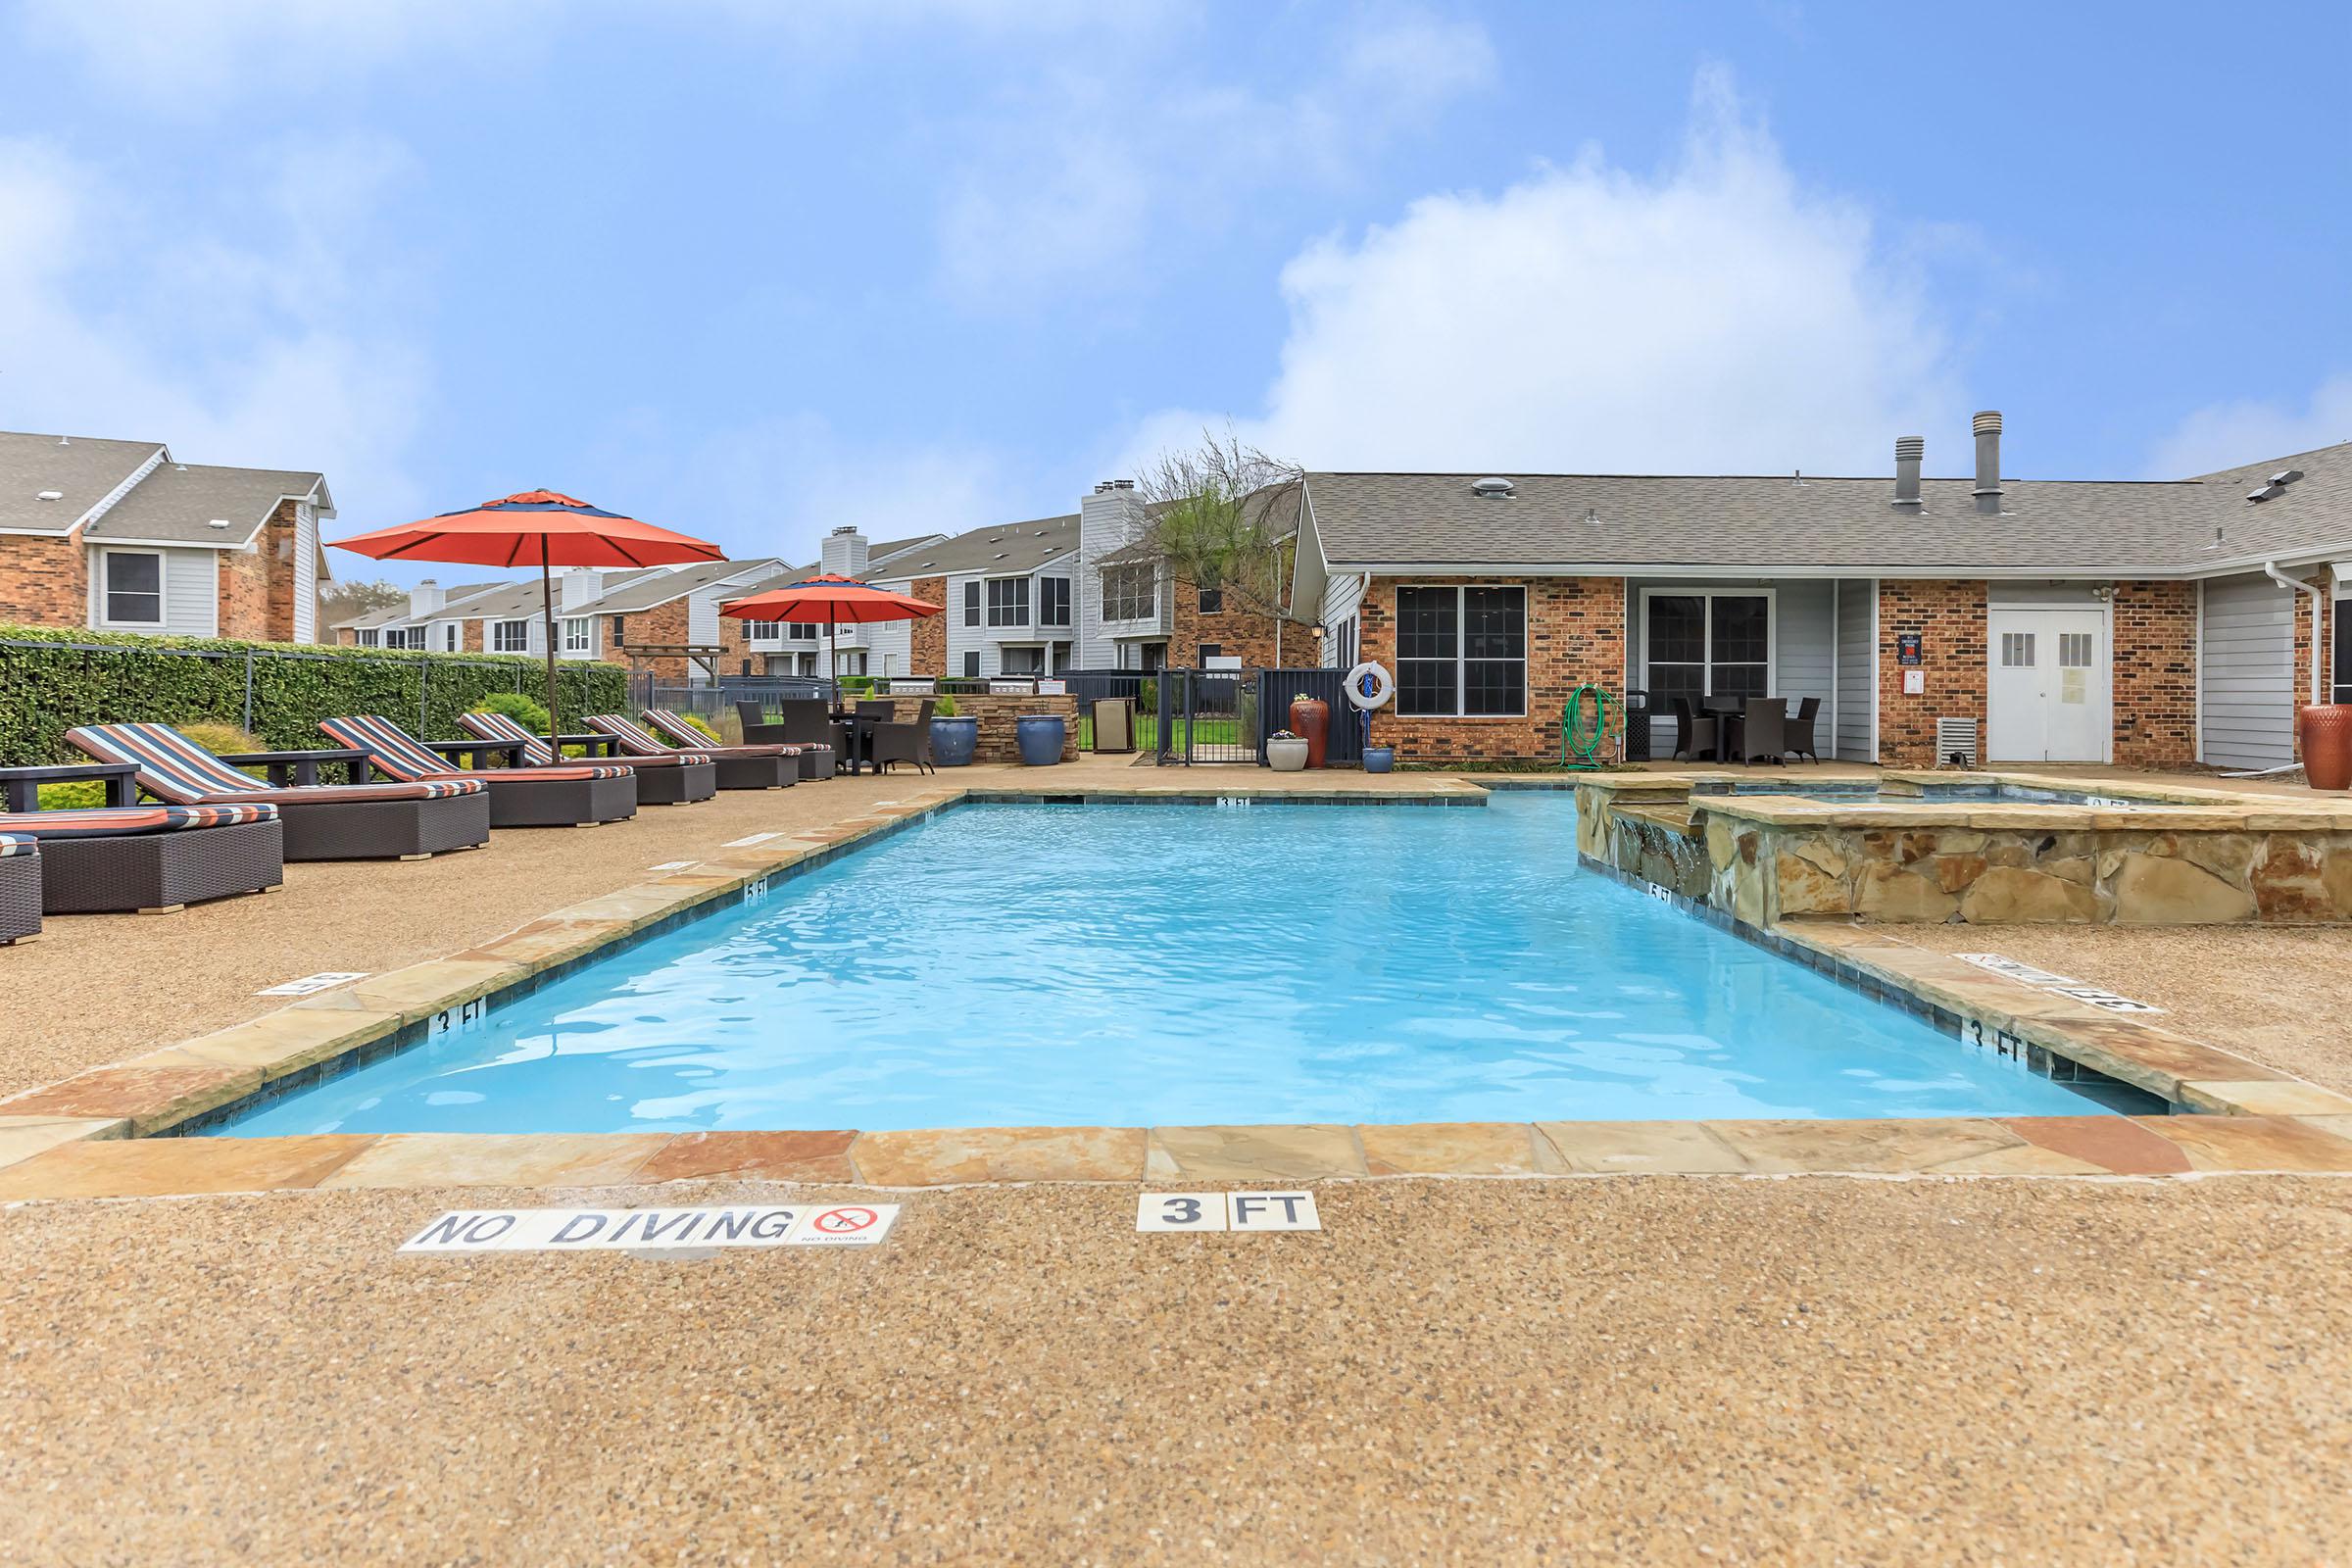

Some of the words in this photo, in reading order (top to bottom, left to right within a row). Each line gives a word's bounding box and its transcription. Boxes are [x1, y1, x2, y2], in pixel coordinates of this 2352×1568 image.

[1221, 797, 1229, 807] 3
[1236, 797, 1248, 806] FT
[437, 1009, 450, 1035] 3
[463, 997, 482, 1026] FT
[1971, 1019, 1984, 1048] 3
[1998, 1030, 2023, 1062] FT
[1161, 1198, 1202, 1224] 3
[1236, 1197, 1306, 1224] FT
[415, 1214, 516, 1245] NO
[549, 1211, 794, 1245] DIVING
